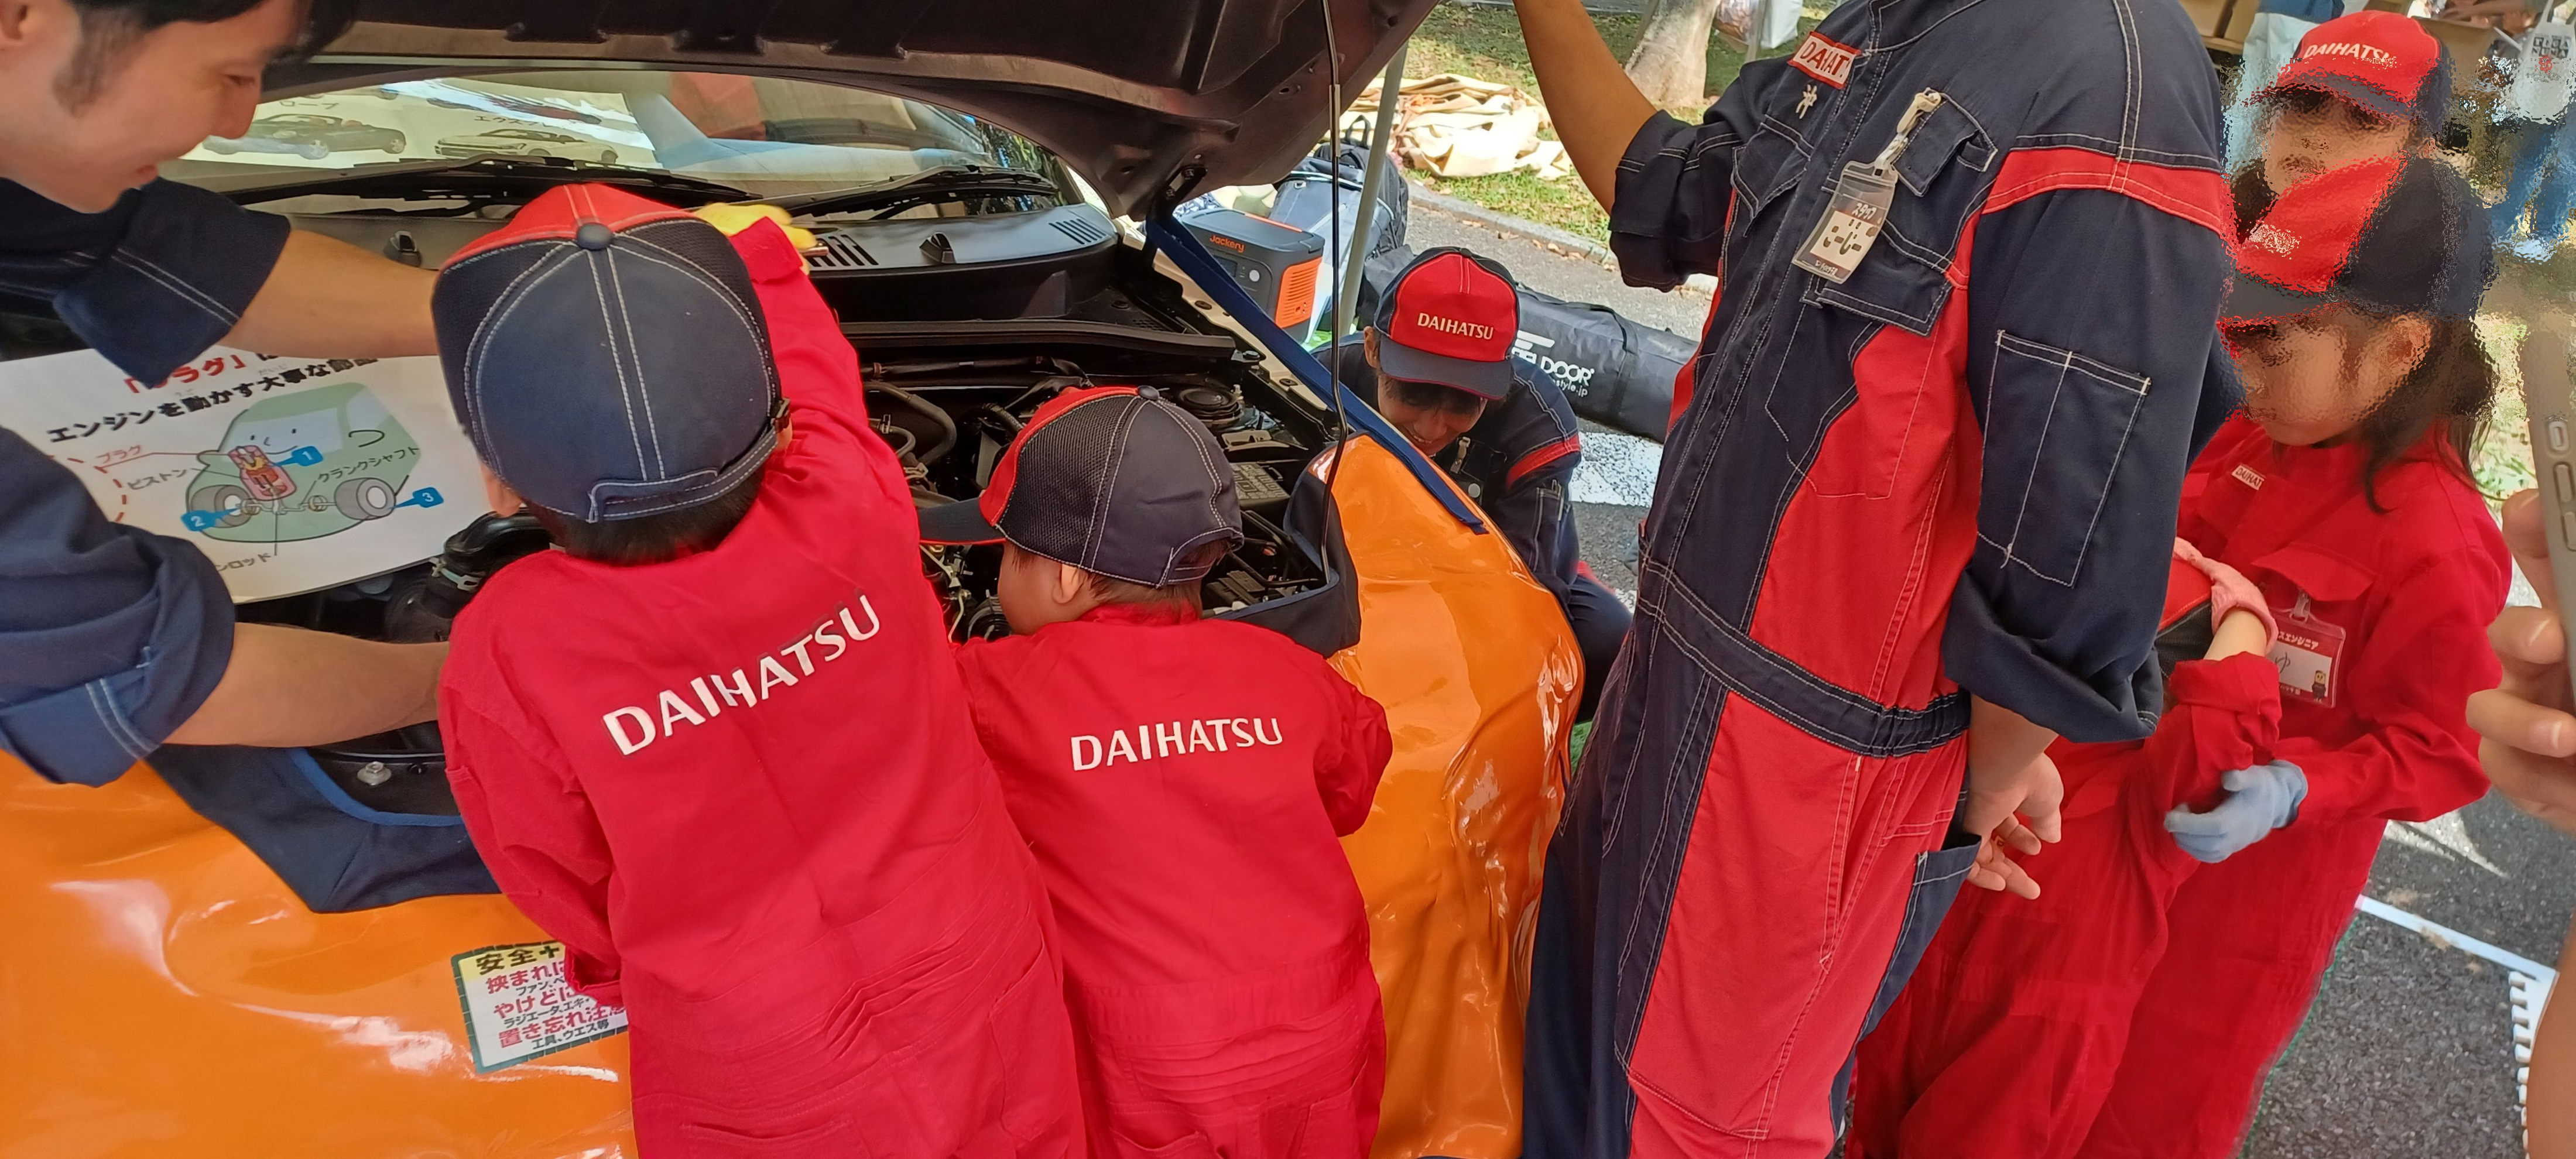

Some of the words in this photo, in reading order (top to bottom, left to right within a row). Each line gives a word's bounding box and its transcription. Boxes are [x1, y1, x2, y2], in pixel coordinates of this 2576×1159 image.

[1210, 235, 1245, 253] Jackery
[1417, 313, 1493, 340] DAIHATSU
[1553, 379, 1588, 397] style.jp
[302, 451, 313, 461] 1
[317, 446, 420, 483] クランクシャフト
[422, 492, 434, 502] 3
[191, 515, 205, 527] 2
[602, 595, 880, 755] DAIHATSU
[1071, 718, 1283, 771] DAIHATSU
[504, 997, 590, 1028] ラジエータ、エキ
